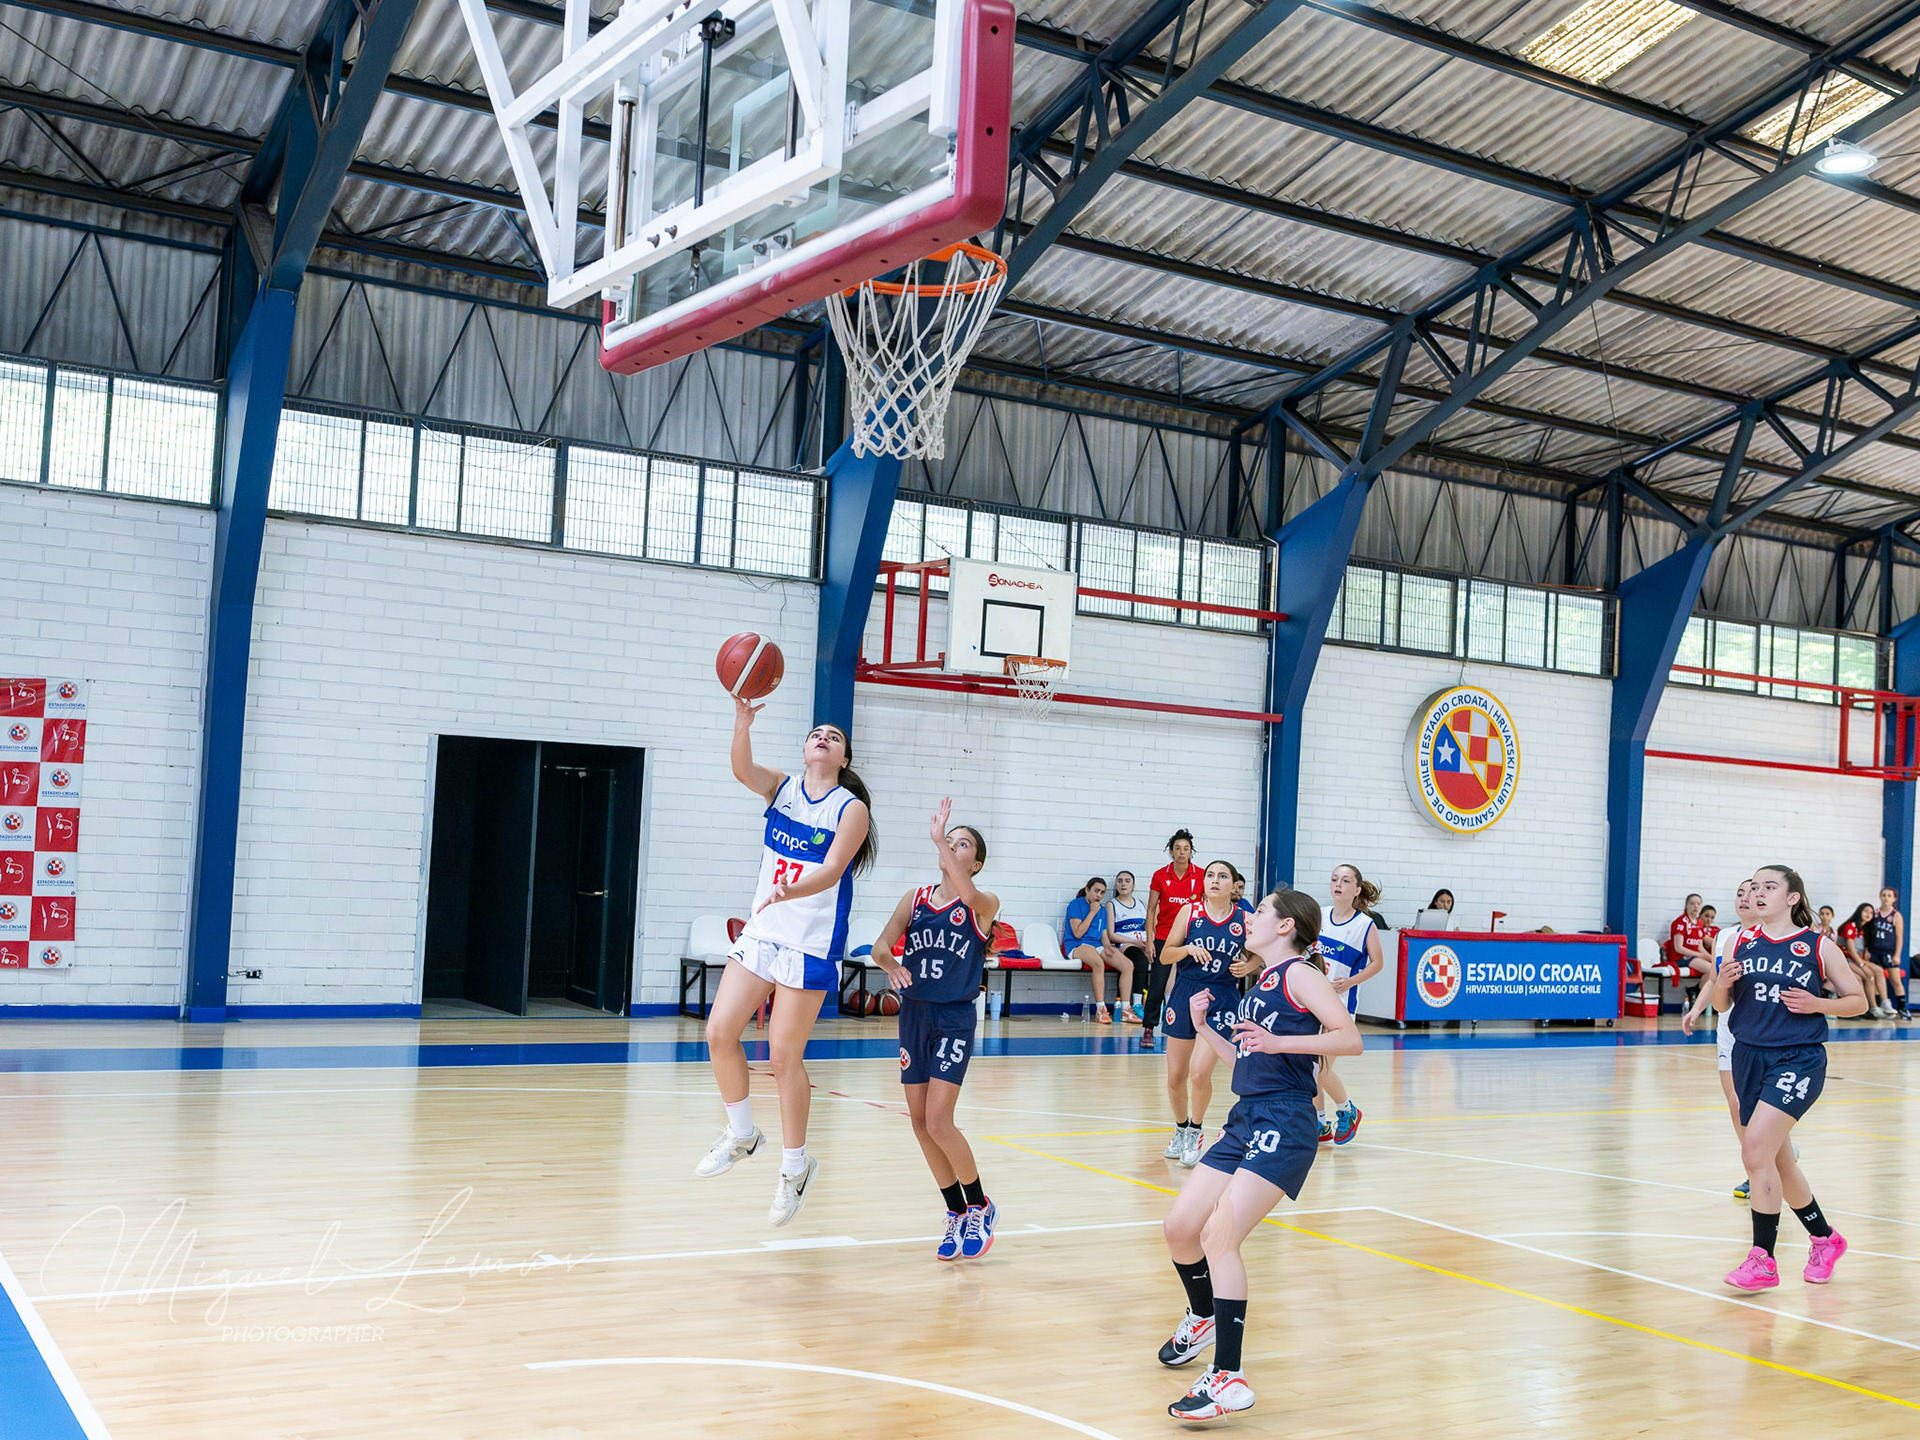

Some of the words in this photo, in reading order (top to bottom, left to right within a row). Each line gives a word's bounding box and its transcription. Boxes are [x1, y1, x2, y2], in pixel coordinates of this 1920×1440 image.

[1451, 694, 1488, 711] CROATA
[1421, 702, 1450, 750] ESTADIO
[1493, 709, 1515, 770] HRVATSKI
[1420, 758, 1435, 797] CHILE
[1497, 772, 1514, 806] KLUB
[1432, 796, 1446, 815] DE
[1445, 807, 1495, 828] SANTIAGO
[772, 827, 809, 852] cmpc
[773, 858, 804, 885] 27
[1168, 896, 1190, 905] cmpc
[919, 958, 944, 980] 15
[1466, 963, 1536, 982] ESTADIO
[1539, 963, 1602, 982] CROATA
[1741, 956, 1813, 988] ROATA
[1465, 984, 1503, 995] HRVATSKI
[1503, 984, 1524, 995] KLUB
[1528, 985, 1568, 995] SANTIAGO
[1568, 985, 1579, 995] DE
[1580, 985, 1602, 995] CHILE
[1754, 981, 1781, 1004] 24
[1212, 1010, 1236, 1027] 19
[936, 1037, 967, 1064] 15
[1775, 1071, 1811, 1100] 24
